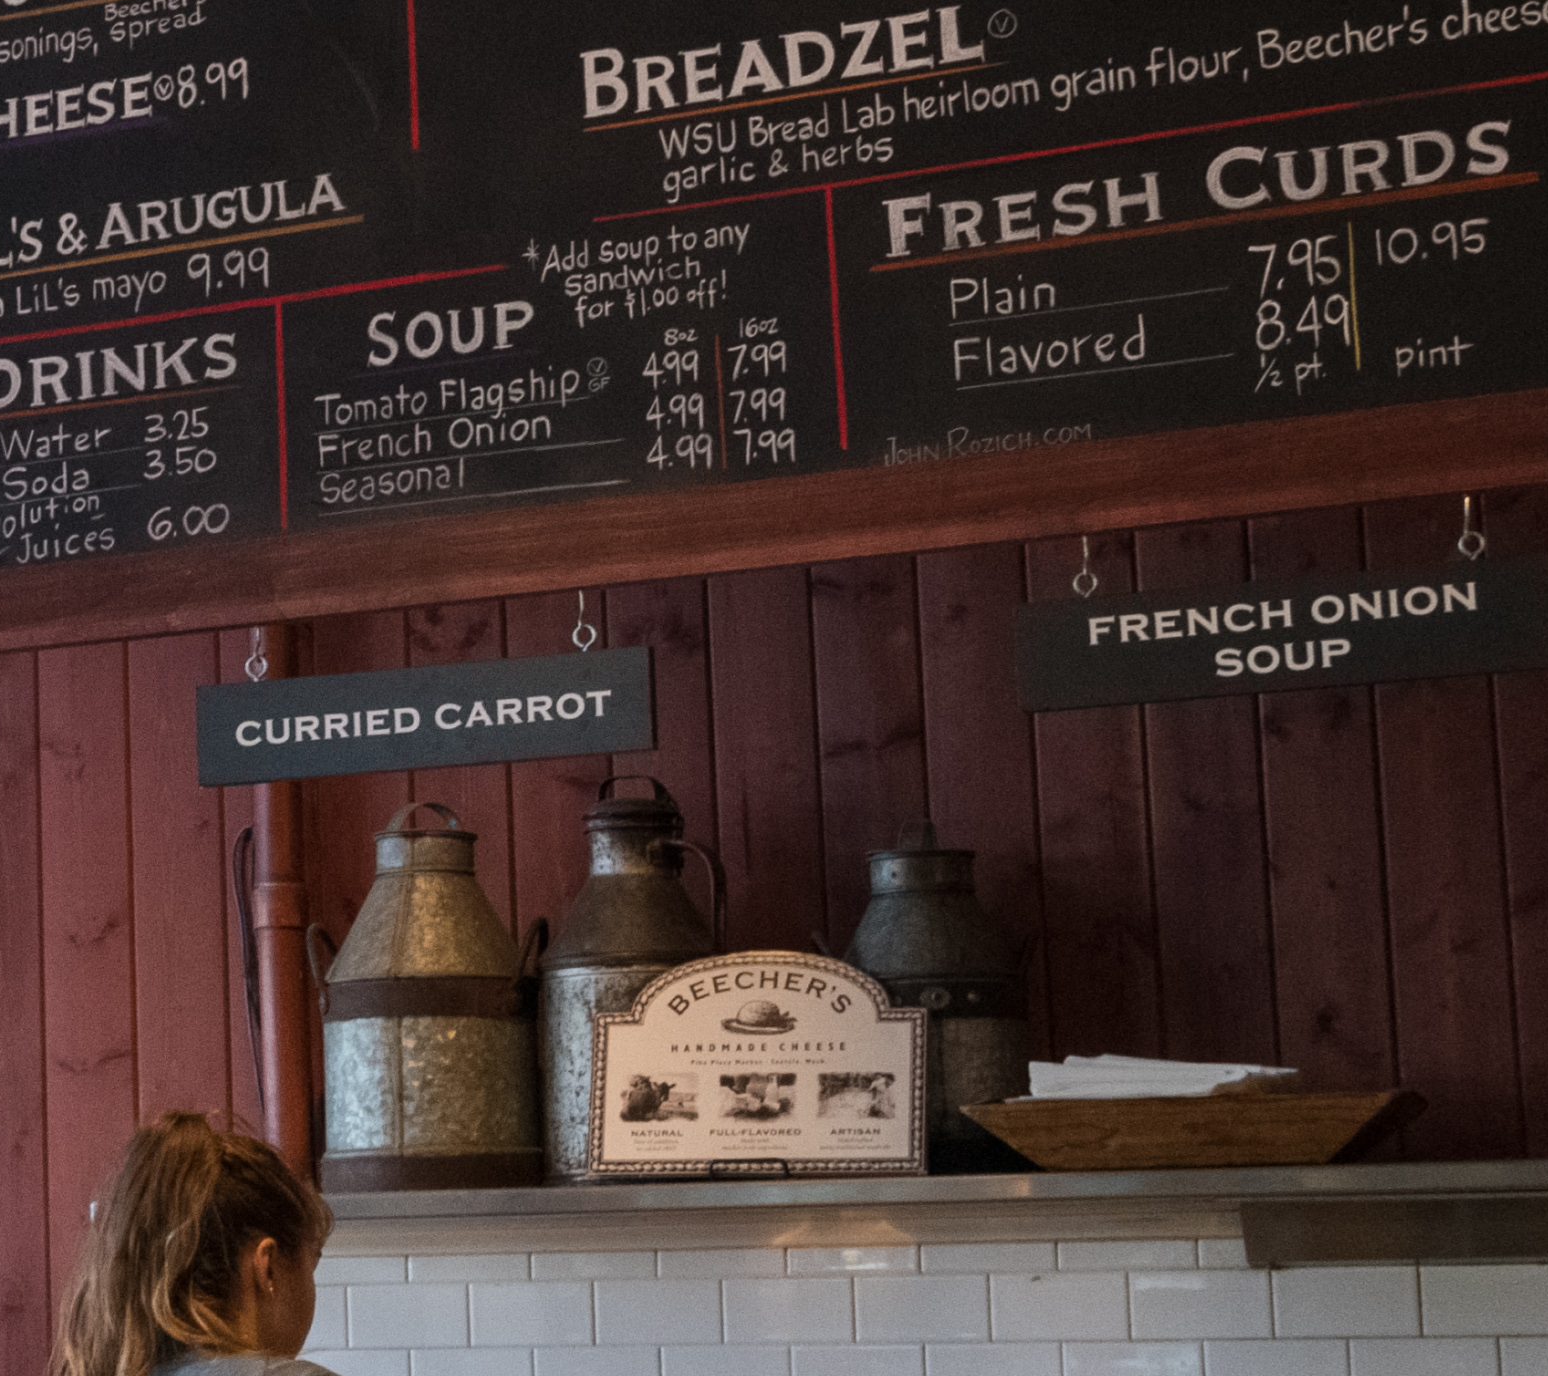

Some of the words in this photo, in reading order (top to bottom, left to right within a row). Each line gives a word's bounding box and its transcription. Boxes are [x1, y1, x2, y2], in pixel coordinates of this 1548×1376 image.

[176, 57, 250, 110] 8.99
[579, 5, 986, 119] BREADZEL
[56, 216, 88, 256] &
[96, 173, 347, 251] ARUGULA
[881, 171, 1165, 260] FRESH
[1205, 120, 1512, 211] CURDS
[187, 248, 271, 300] 9.99
[950, 274, 1056, 318] Plain
[1248, 235, 1342, 299] 7.95
[1376, 219, 1490, 267] 10.95
[367, 300, 533, 367] SOUP
[954, 315, 1147, 381] Flavored
[1255, 294, 1353, 351] 8.49
[1395, 338, 1473, 377] pint
[314, 388, 428, 427] Tomato
[439, 366, 581, 416] Flagship
[641, 350, 700, 388] 4.99
[727, 342, 788, 380] 7.99
[0, 422, 111, 461] Water
[144, 407, 209, 443] 3.25
[318, 424, 432, 466] French
[448, 413, 552, 450] Onion
[646, 395, 704, 432] 4.99
[728, 388, 786, 425] 7.99
[3, 461, 90, 500] Soda
[143, 446, 217, 479] 3.50
[319, 457, 465, 504] Seasonal
[646, 432, 714, 469] 4.99
[733, 428, 797, 465] 7.99
[16, 523, 116, 563] Juices
[147, 503, 230, 541] 6.00
[1088, 599, 1293, 646] FRENCH
[1310, 581, 1479, 624] ONION
[1215, 638, 1352, 677] SOUP
[234, 704, 421, 748] CURRIED
[432, 688, 612, 730] CARROT
[668, 971, 852, 1016] BEECHER'S
[671, 1043, 767, 1053] HANDMADE
[779, 1042, 846, 1052] CHEESE
[631, 1129, 684, 1137] NATURAL
[830, 1127, 881, 1135] ARTISAN
